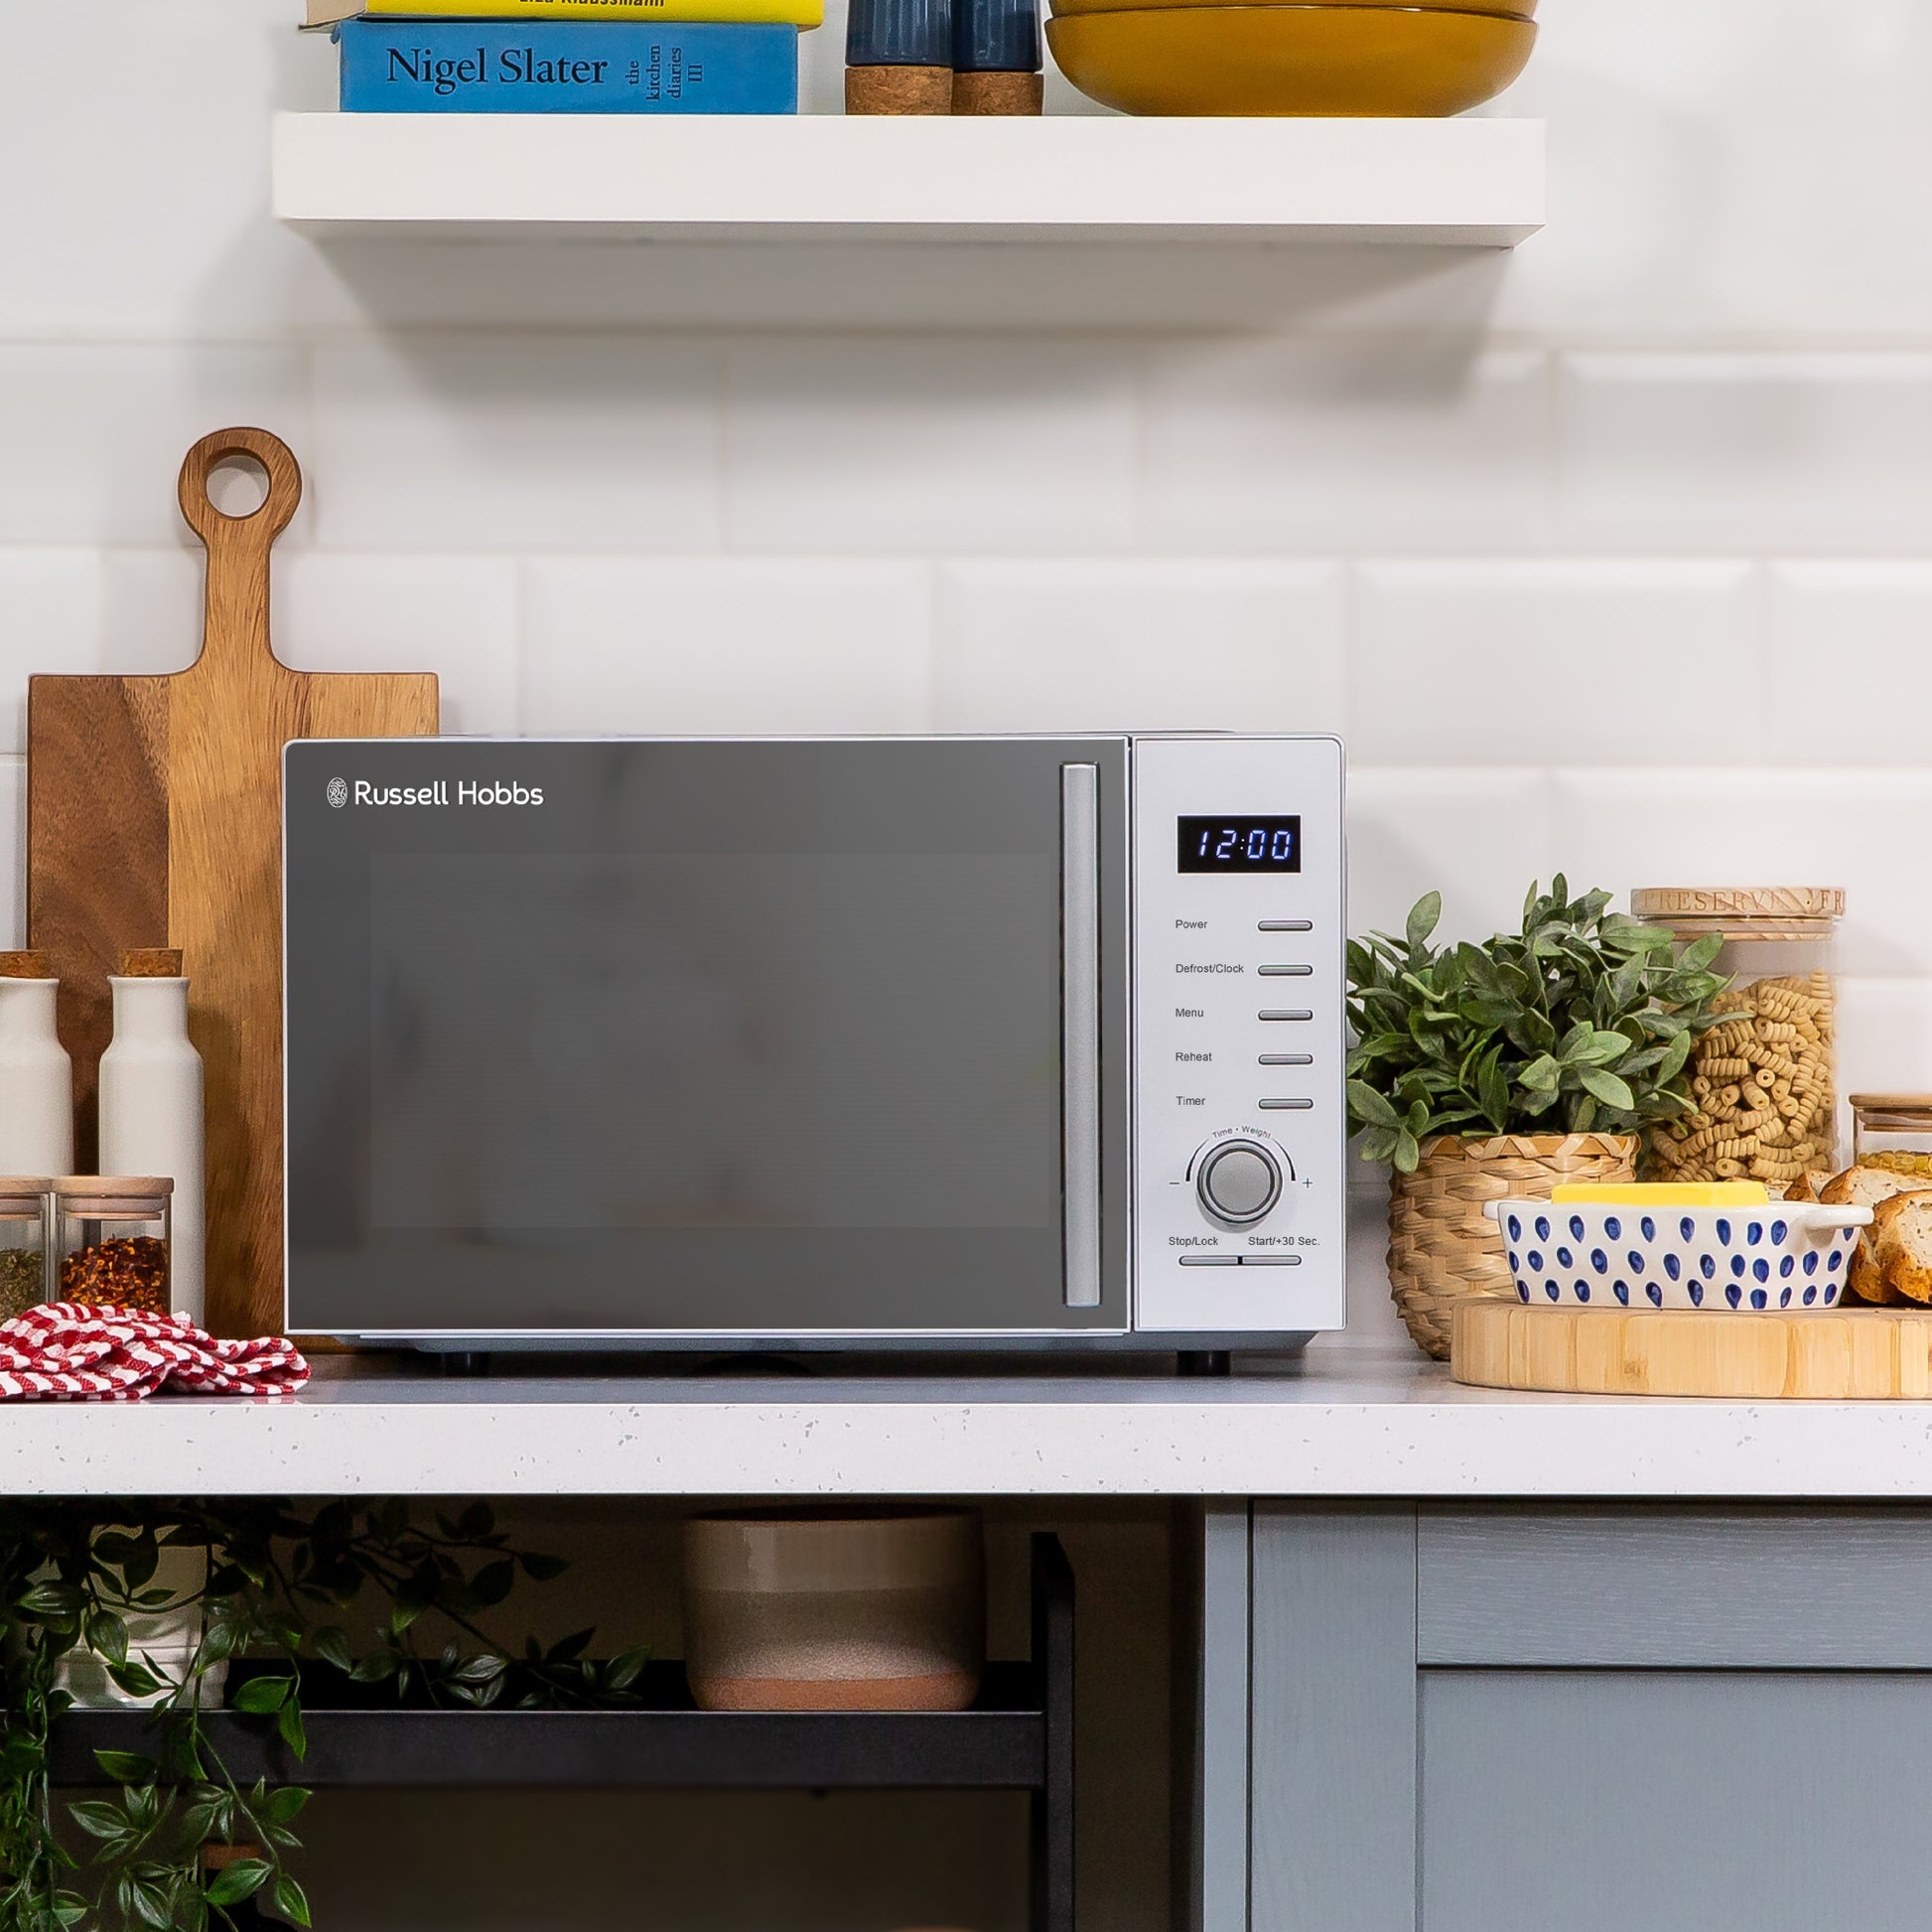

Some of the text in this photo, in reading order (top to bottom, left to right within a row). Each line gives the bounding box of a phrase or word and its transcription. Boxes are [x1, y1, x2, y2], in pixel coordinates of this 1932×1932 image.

[386, 47, 609, 95] Nigel Slater
[624, 61, 640, 85] the
[644, 45, 661, 101] kitchen
[666, 47, 682, 99] diaries
[687, 65, 703, 82] III
[354, 780, 450, 805] Russell
[458, 780, 544, 806] Hobbs
[1197, 830, 1291, 860] 12:00
[1174, 918, 1208, 929] Power
[1175, 963, 1244, 974] Defrost/Clock
[1174, 1008, 1204, 1018] Menu
[1174, 1051, 1212, 1062] Reheat
[1175, 1095, 1206, 1106] Timer
[1212, 1125, 1271, 1139] Time Weight
[1169, 1236, 1219, 1248] Stop/Lock
[1248, 1236, 1320, 1246] Start/+30 Sec.
